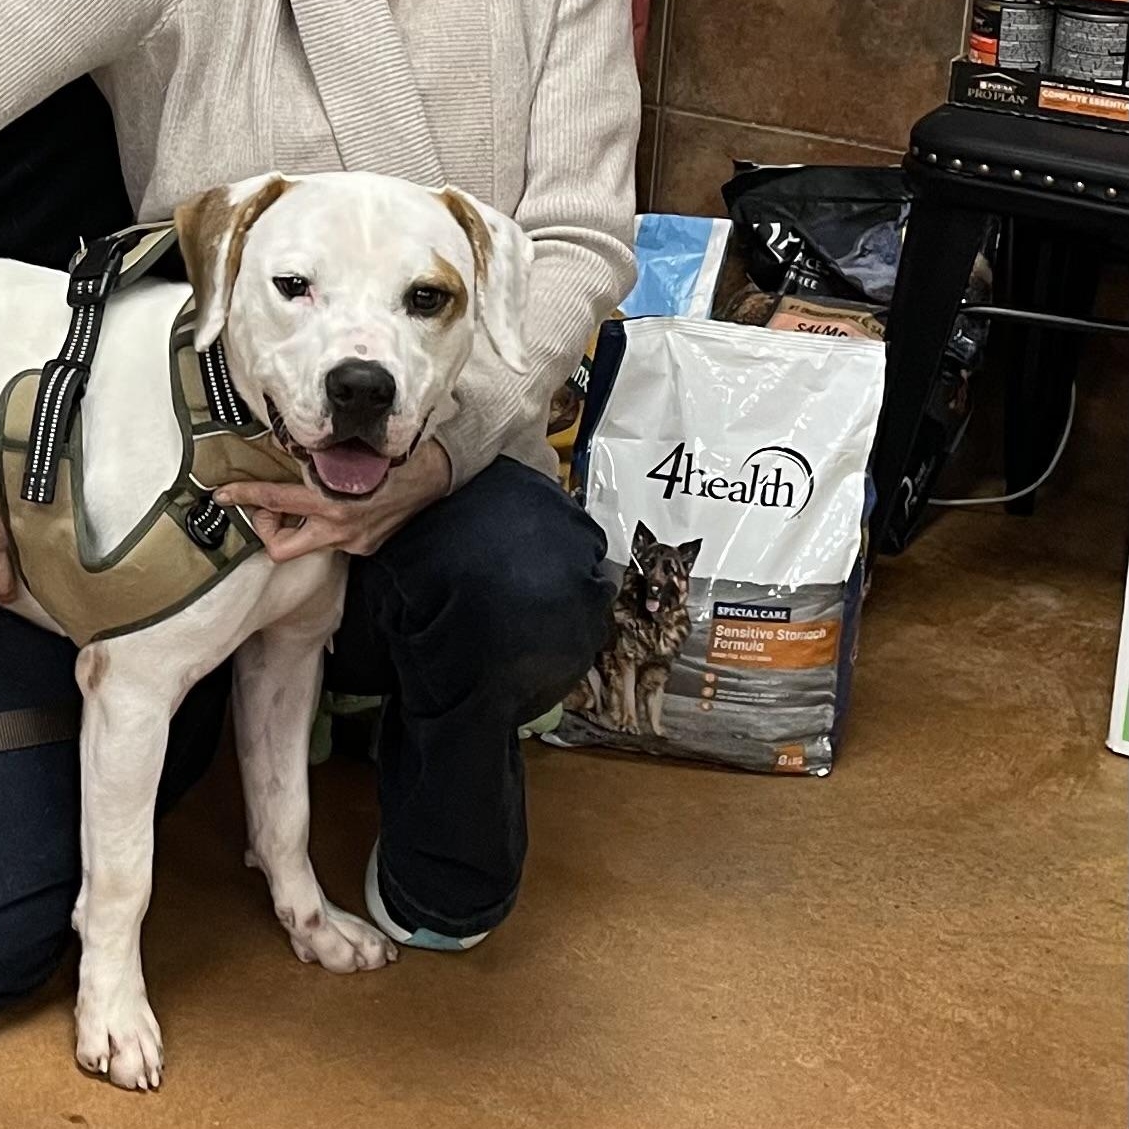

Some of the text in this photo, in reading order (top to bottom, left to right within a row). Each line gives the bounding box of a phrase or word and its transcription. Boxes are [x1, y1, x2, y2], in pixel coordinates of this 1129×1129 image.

[968, 88, 1025, 105] PRO PLAN
[1042, 90, 1088, 104] COMPLETE
[646, 442, 796, 509] 4health
[717, 607, 788, 620] SPECIAL CARE
[715, 625, 827, 641] Sensitive Stomach
[713, 637, 765, 652] Formula
